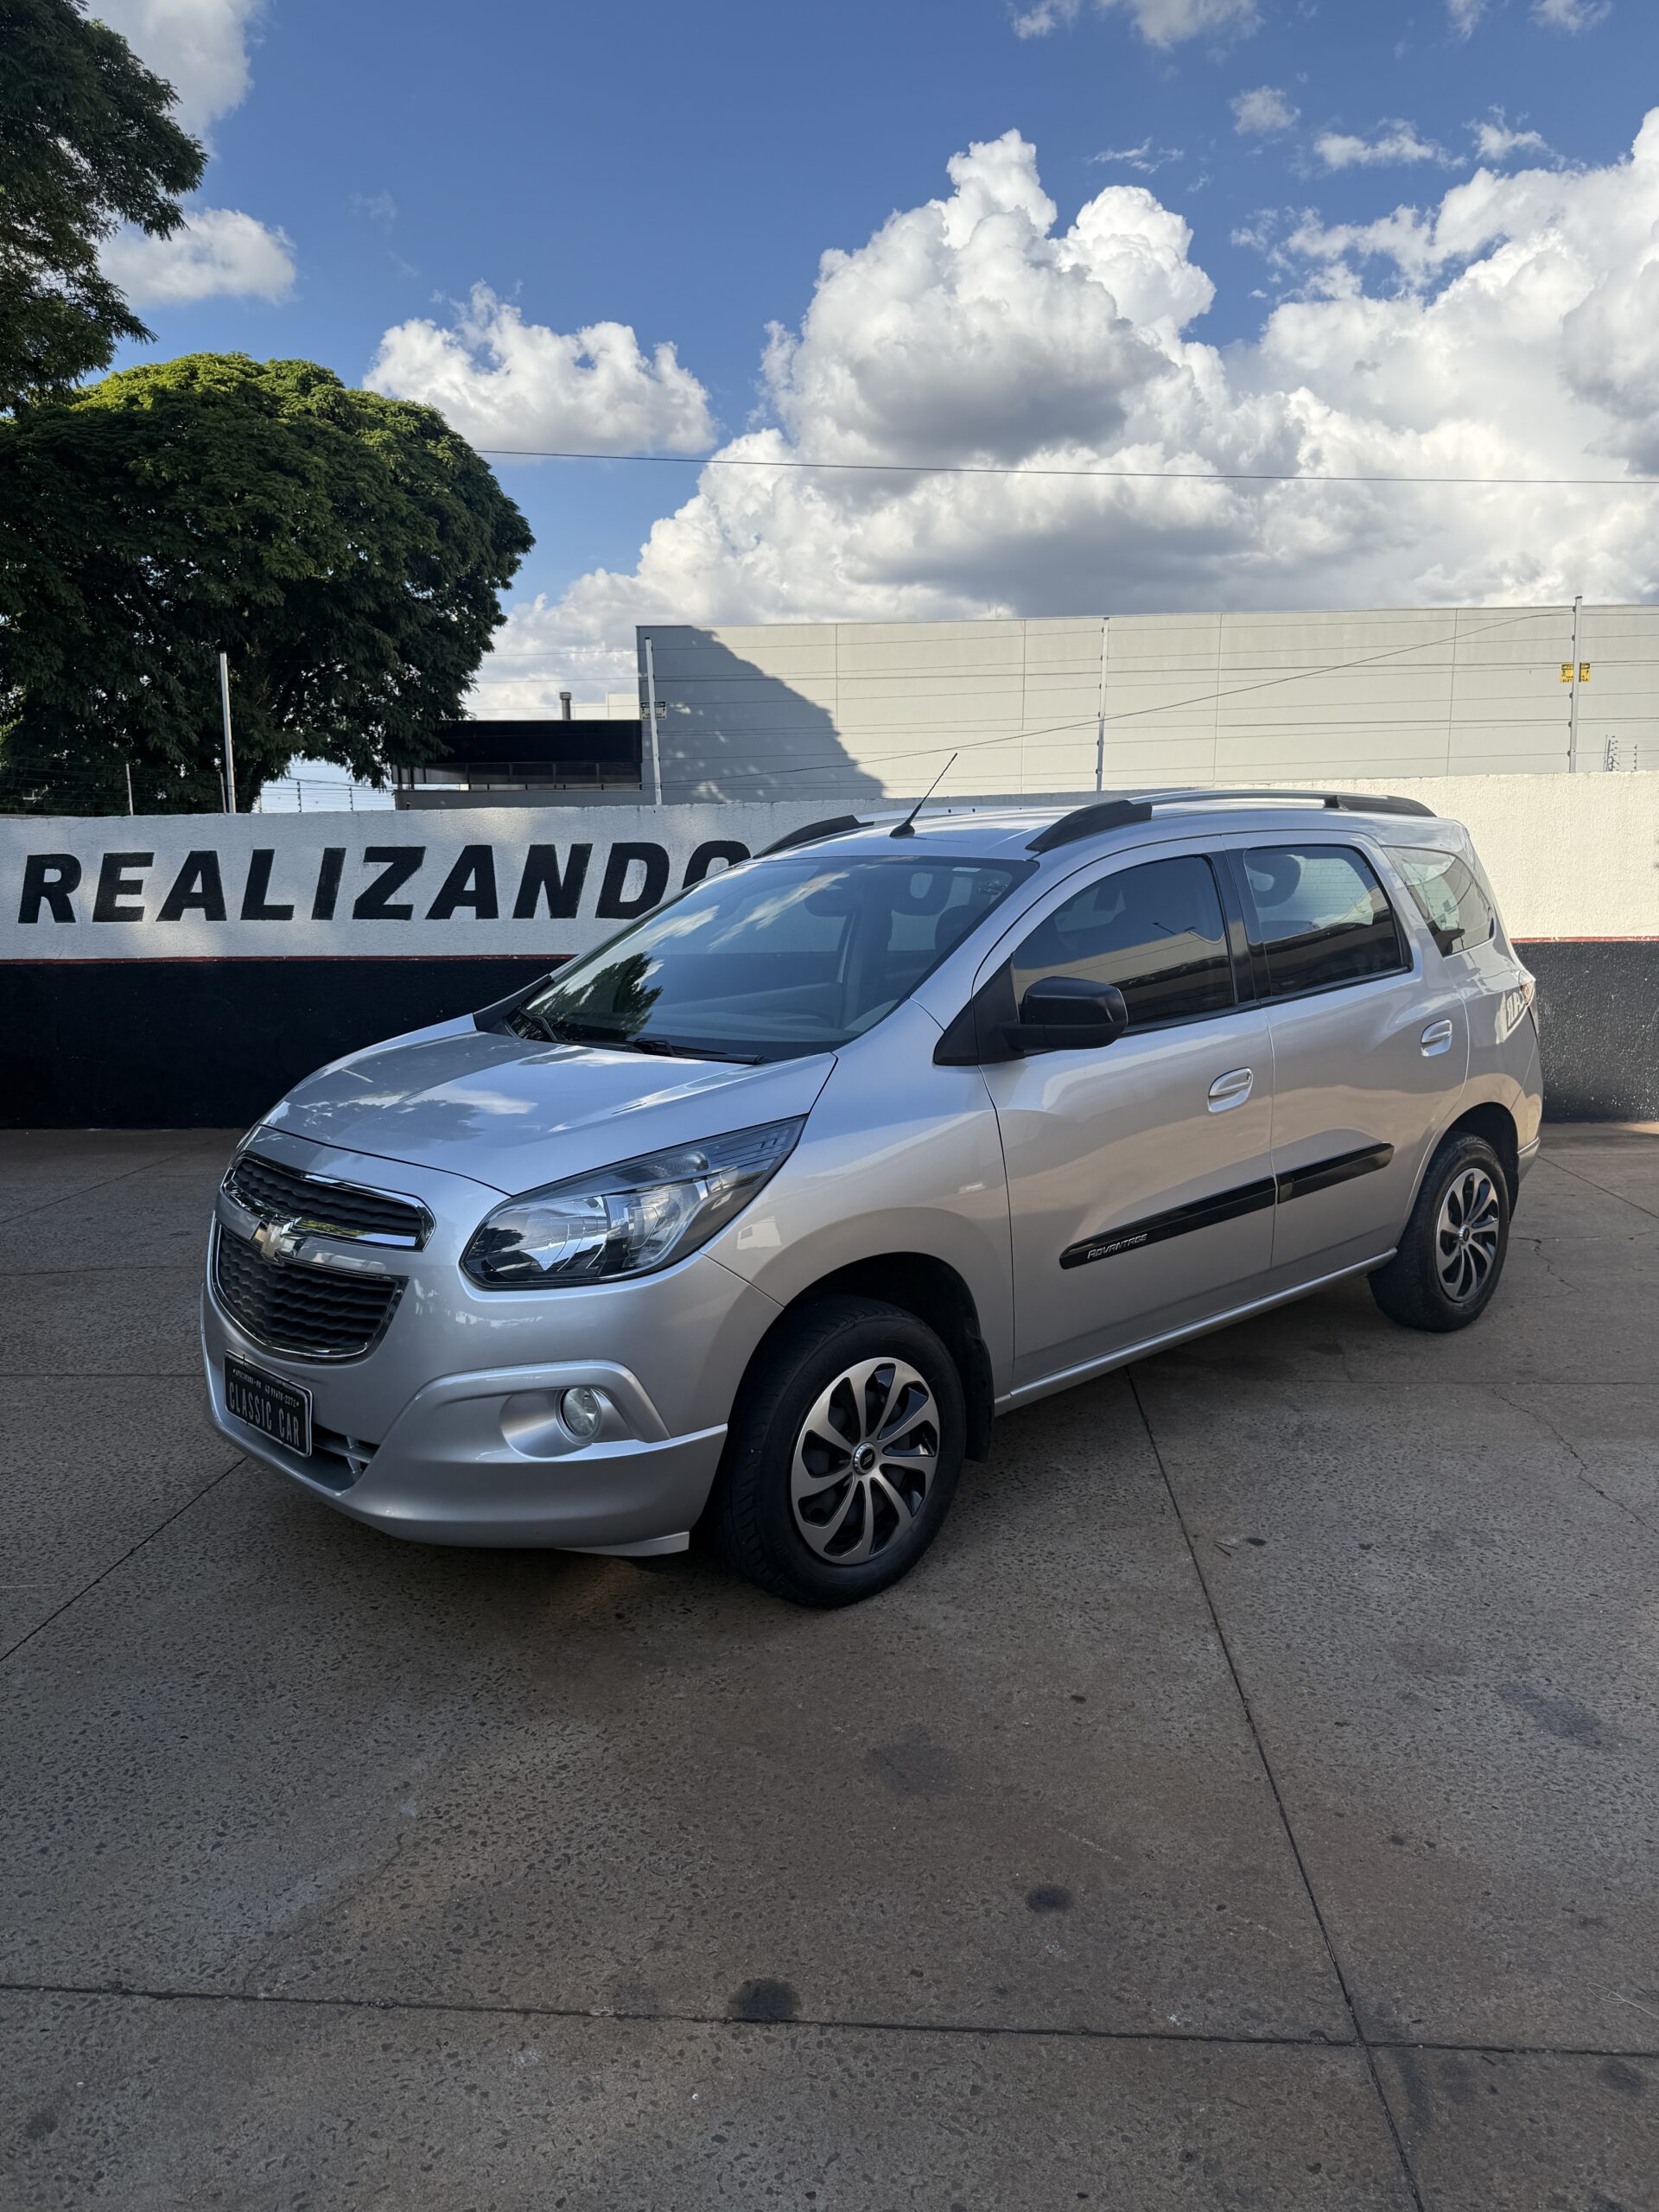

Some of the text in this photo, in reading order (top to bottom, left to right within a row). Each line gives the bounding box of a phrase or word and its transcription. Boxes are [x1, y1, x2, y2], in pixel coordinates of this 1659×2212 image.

[1087, 1233, 1147, 1260] ADVANTAGE
[229, 1382, 300, 1447] CLASSIC CAR
